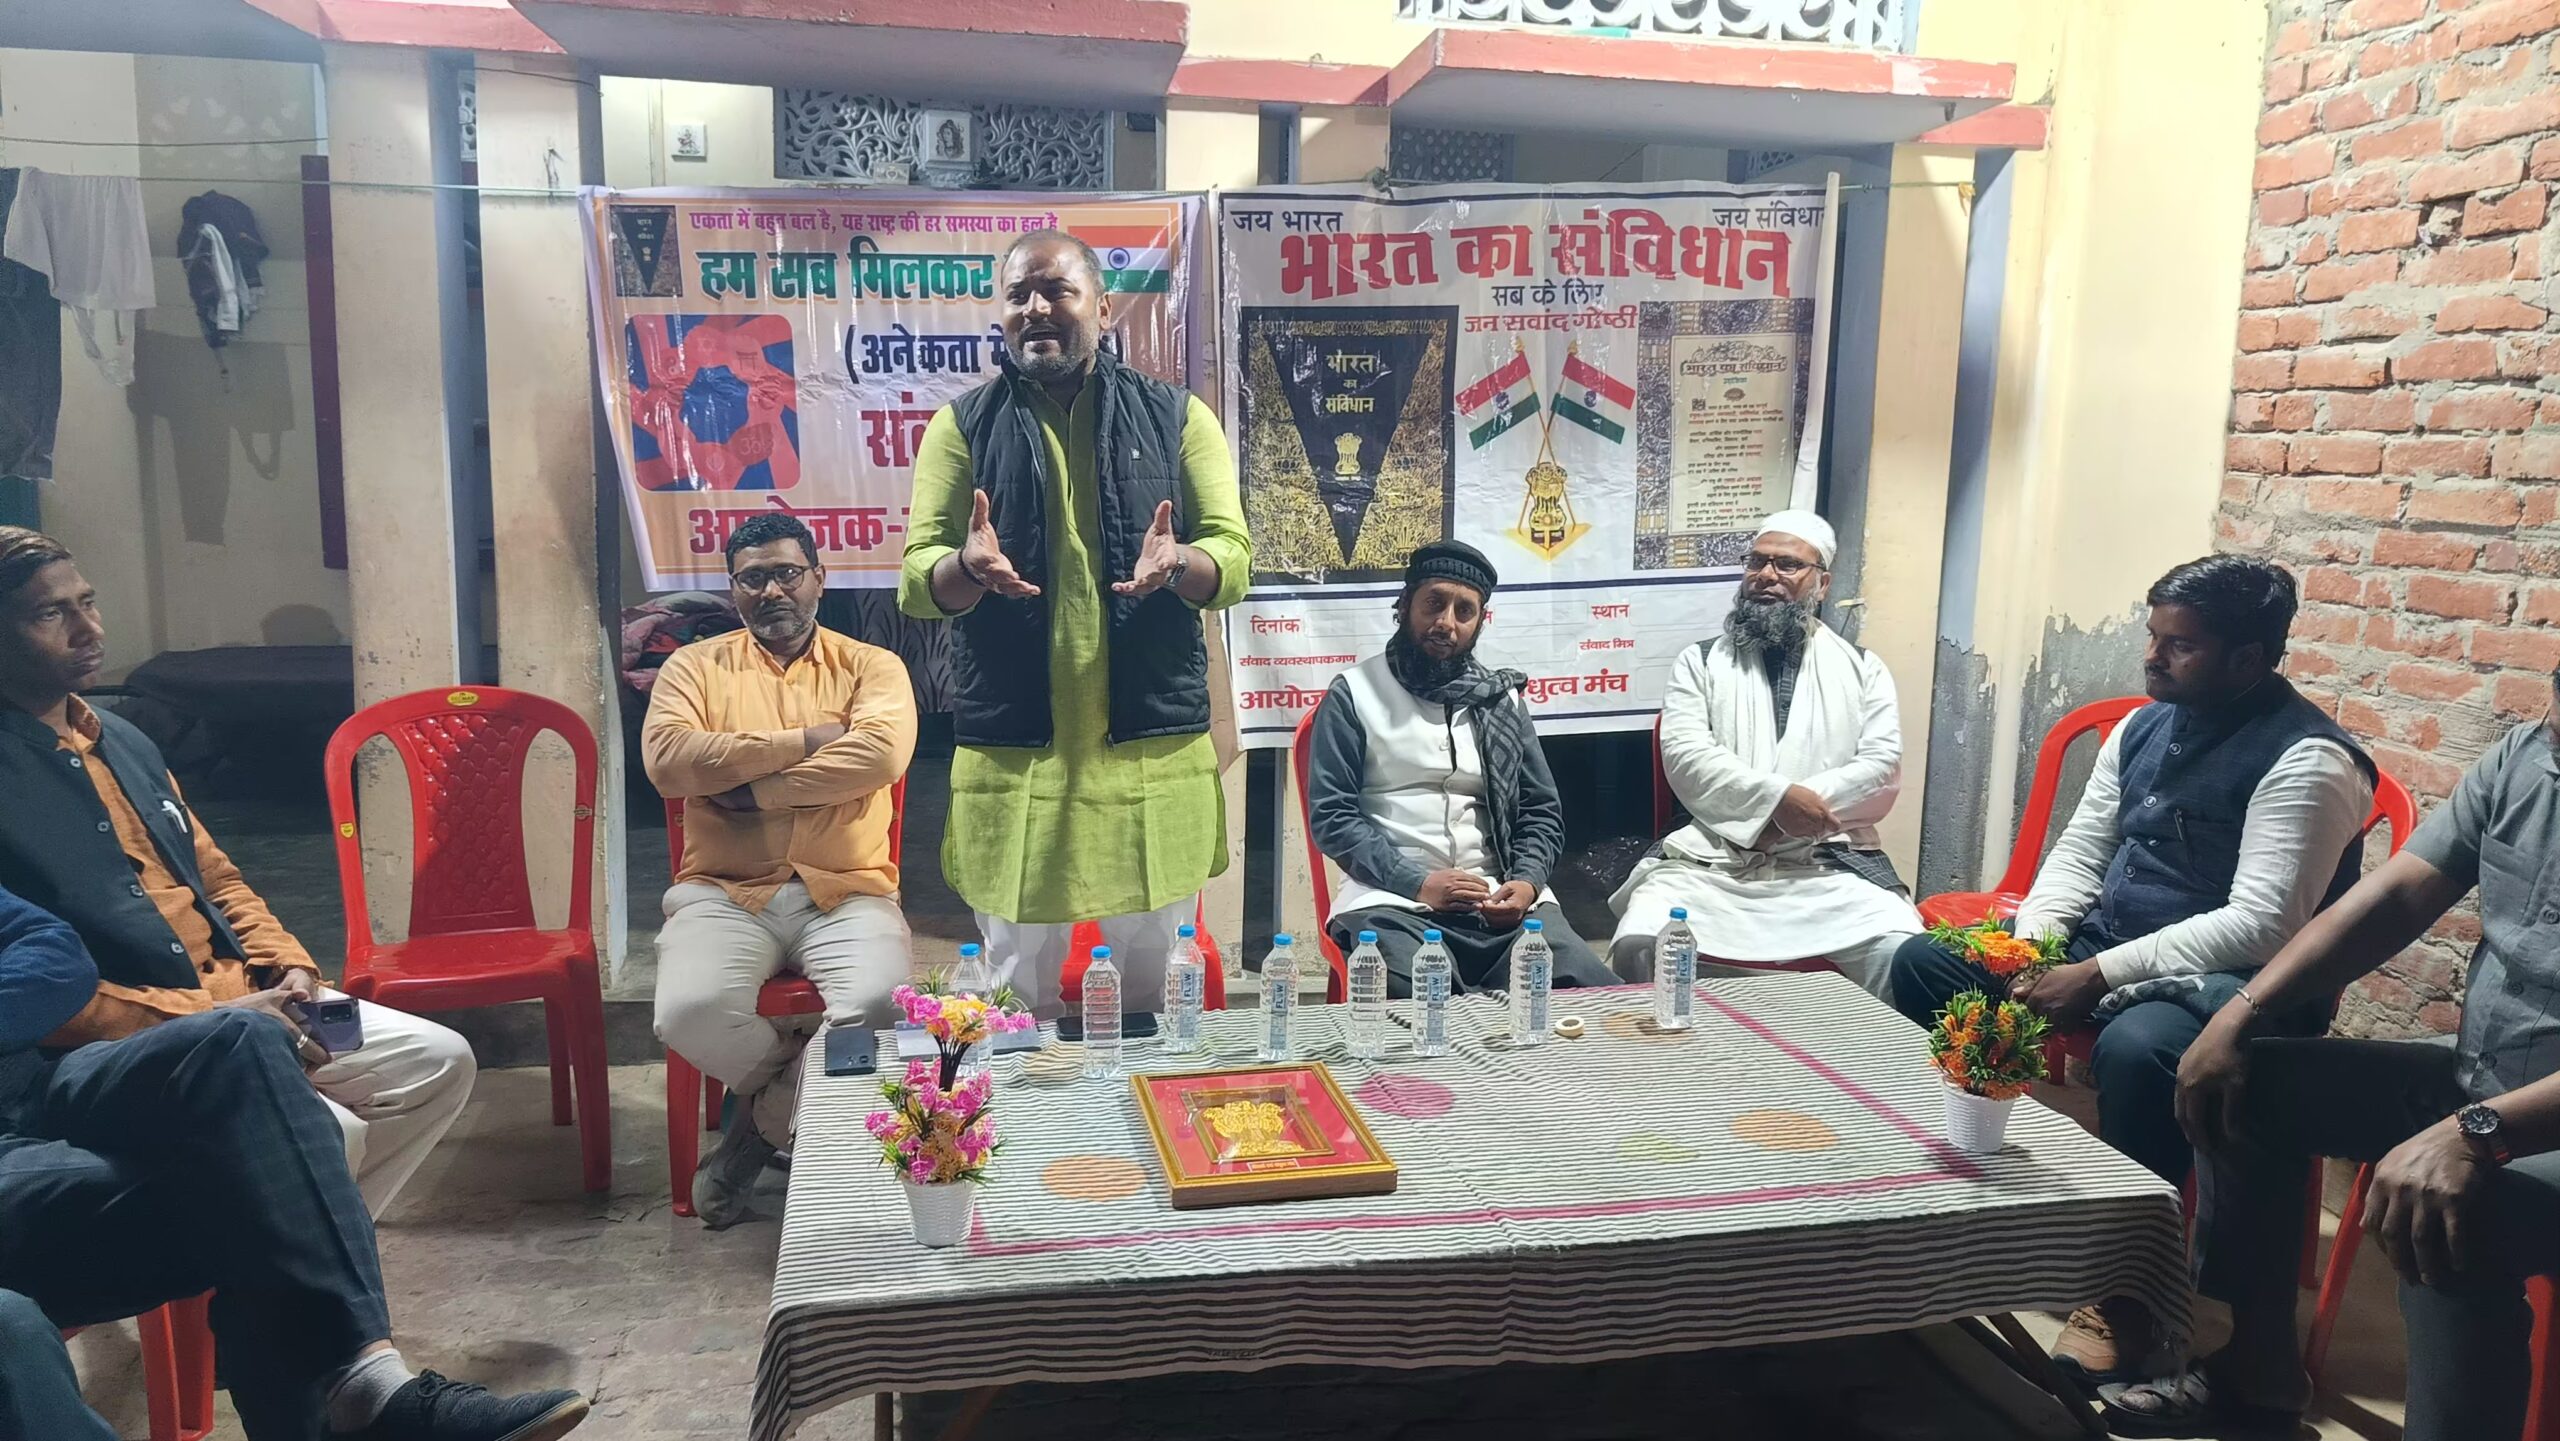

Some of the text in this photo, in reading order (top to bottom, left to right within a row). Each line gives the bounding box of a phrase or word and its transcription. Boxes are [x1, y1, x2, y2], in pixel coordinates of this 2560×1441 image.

[690, 213, 733, 230] एकता
[737, 208, 752, 230] में
[754, 213, 786, 235] बहुत
[790, 213, 816, 230] बल
[841, 213, 864, 231] यह
[867, 214, 895, 235] राष्ट्र
[899, 211, 920, 232] की
[924, 215, 942, 232] हर
[945, 215, 993, 233] समस्या
[997, 215, 1017, 233] का
[1020, 216, 1045, 233] हल
[1045, 212, 1058, 231] है
[1230, 211, 1344, 232] जय भारत
[1713, 208, 1750, 228] जय
[1281, 209, 1792, 300] भारत का संविधान
[695, 235, 996, 300] हम सब मिलकर
[1491, 278, 1604, 306] सब के लिए
[1464, 315, 1499, 333] जन
[1573, 305, 1639, 331] गोष्ठी
[1326, 353, 1376, 373] भारत
[1343, 379, 1358, 389] का
[1325, 394, 1375, 414] संविधान
[1591, 604, 1629, 620] स्थान
[1250, 615, 1300, 636] दिनांक
[1579, 638, 1635, 650] संवाद मित्र
[1239, 655, 1271, 666] संवाद
[1240, 685, 1328, 709] आयोज
[1584, 668, 1629, 693] मंच
